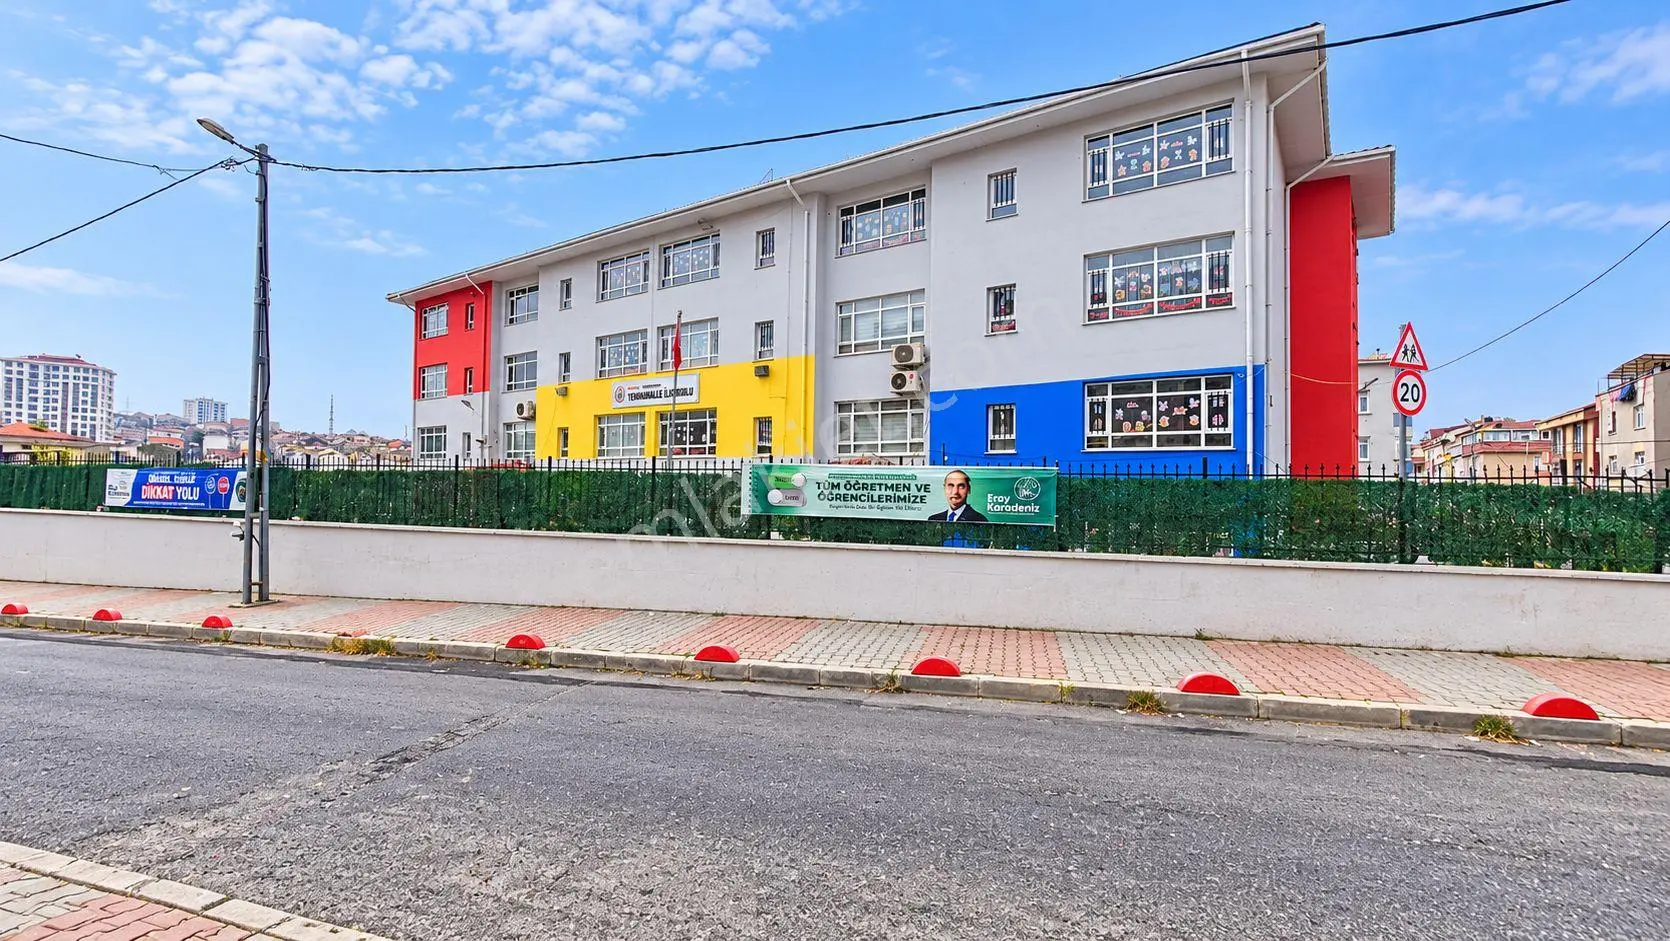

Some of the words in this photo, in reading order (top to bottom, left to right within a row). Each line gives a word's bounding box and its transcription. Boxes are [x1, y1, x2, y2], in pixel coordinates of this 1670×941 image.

[1400, 382, 1420, 403] 20
[142, 483, 174, 501] DİKKAT
[176, 486, 199, 501] YOLU
[815, 480, 841, 491] TÜM
[843, 480, 911, 492] ÖĞRETMEN
[915, 483, 931, 493] VE
[817, 490, 927, 504] ÖĞRENCİLERİMİZE
[987, 494, 1010, 504] Eray
[987, 503, 1040, 513] Karadeniz
